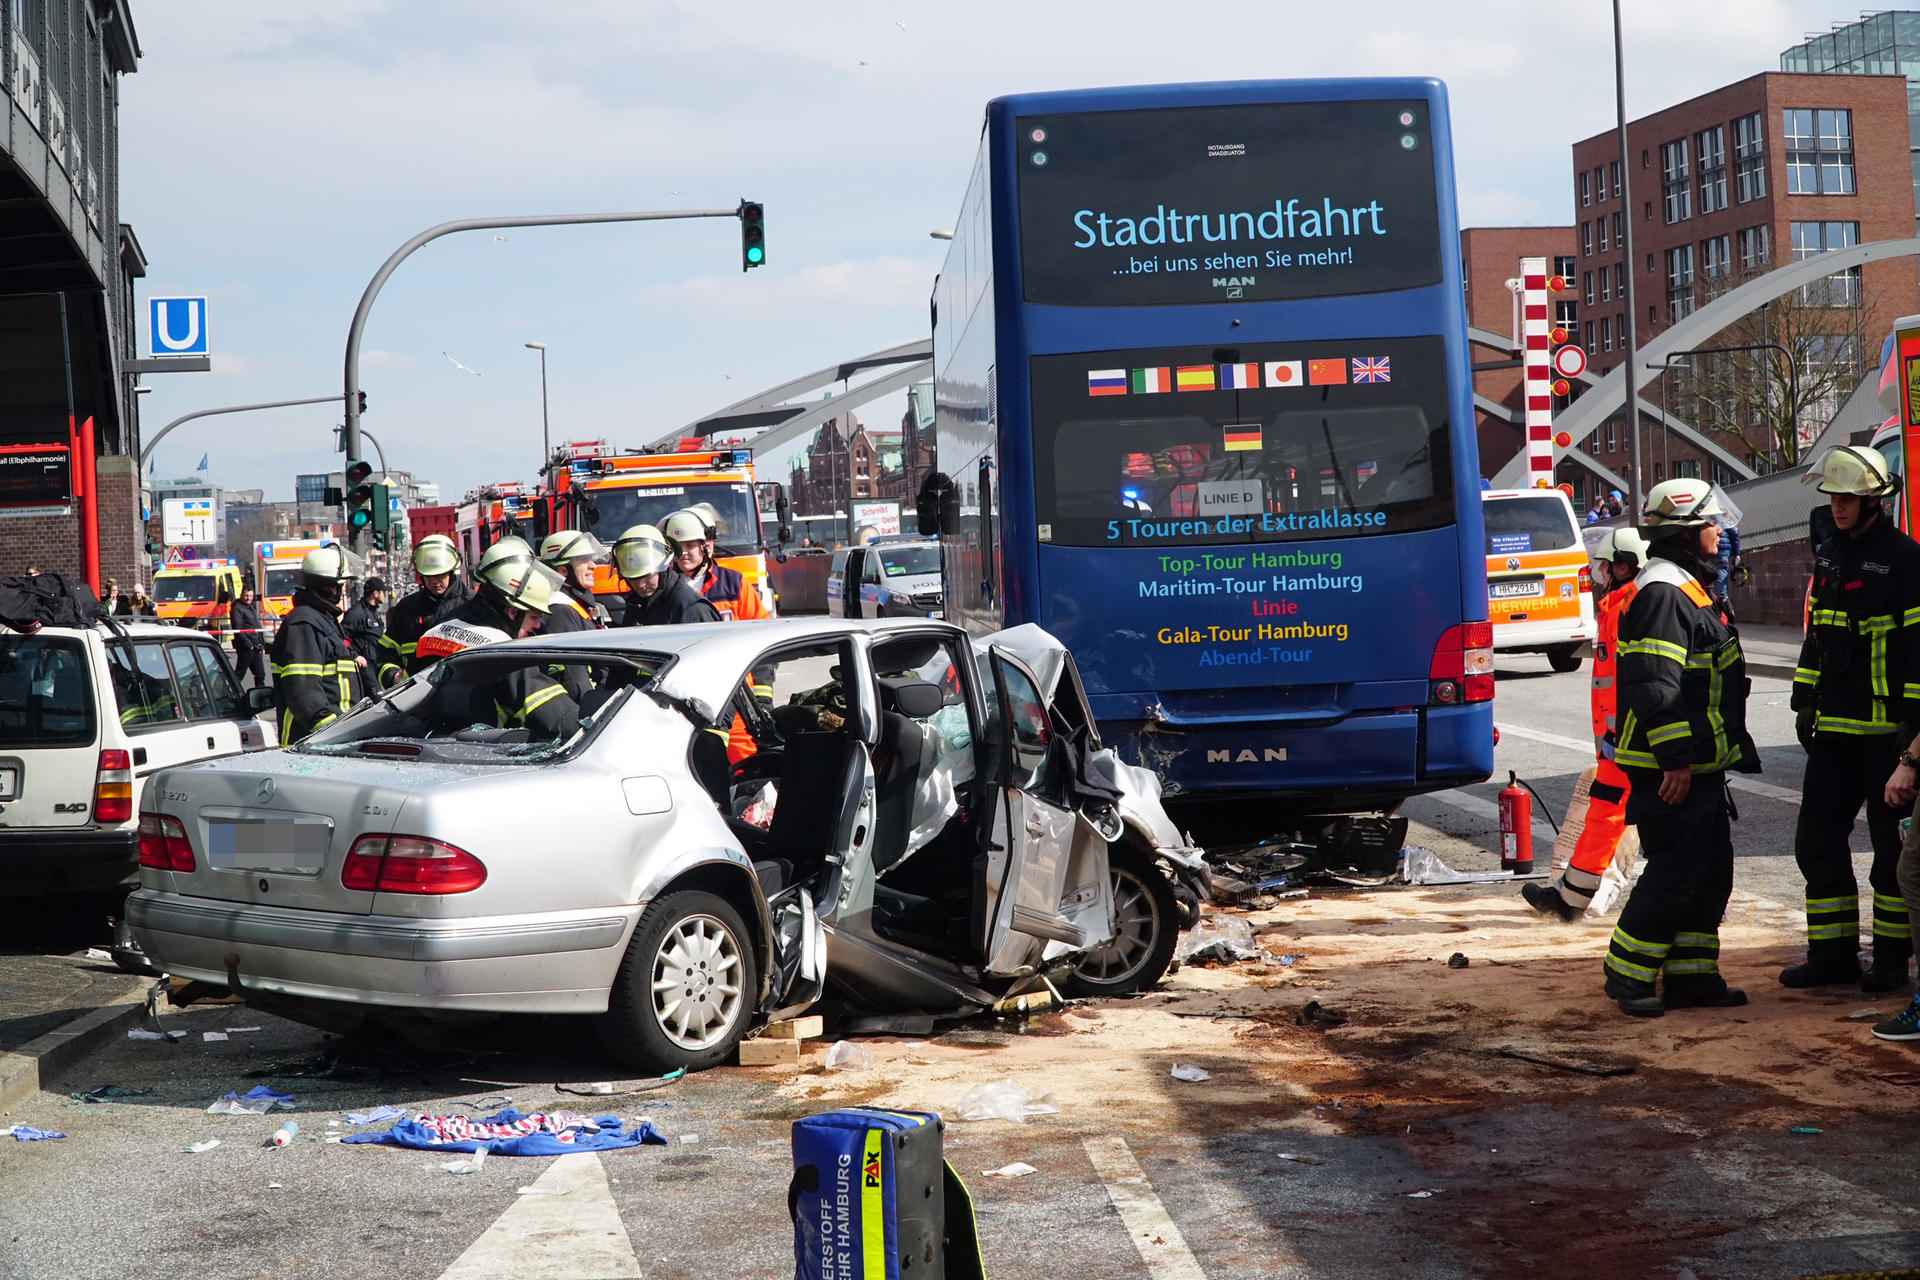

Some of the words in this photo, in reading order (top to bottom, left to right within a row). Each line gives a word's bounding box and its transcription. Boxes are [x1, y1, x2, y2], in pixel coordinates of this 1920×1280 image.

[1074, 197, 1387, 249] Stadtrundfahrt
[1112, 255, 1159, 275] ...bei
[1165, 257, 1198, 272] uns
[1203, 253, 1259, 271] sehen
[1265, 250, 1292, 268] Sie
[1297, 246, 1354, 266] mehr!
[1212, 275, 1257, 288] MAN
[157, 301, 199, 350] U
[9, 454, 67, 465] (Elbphilharmonie)
[1203, 492, 1240, 505] LINIE
[1243, 491, 1254, 503] D
[861, 505, 889, 517] Schreib!
[882, 515, 898, 523] Dein!
[880, 526, 900, 536] Buch!
[1107, 520, 1120, 540] 5
[1127, 516, 1209, 538] Touren
[1216, 513, 1255, 535] der
[1262, 509, 1387, 533] Extraklasse
[1158, 552, 1247, 574] Top-Tour
[1252, 549, 1343, 572] Hamburg
[1138, 576, 1267, 599] Maritim-Tour
[1272, 572, 1364, 594] Hamburg
[1499, 585, 1511, 594] HH
[1515, 583, 1535, 592] 2918
[1252, 598, 1299, 617] Linie
[1157, 624, 1253, 646] Gala-Tour
[1257, 621, 1350, 643] Hamburg
[1199, 646, 1314, 667] Abend-Tour
[1206, 747, 1288, 763] MAN
[362, 805, 389, 816] CDI
[864, 1151, 880, 1188] PAX
[837, 1153, 852, 1248] HAMBURG
